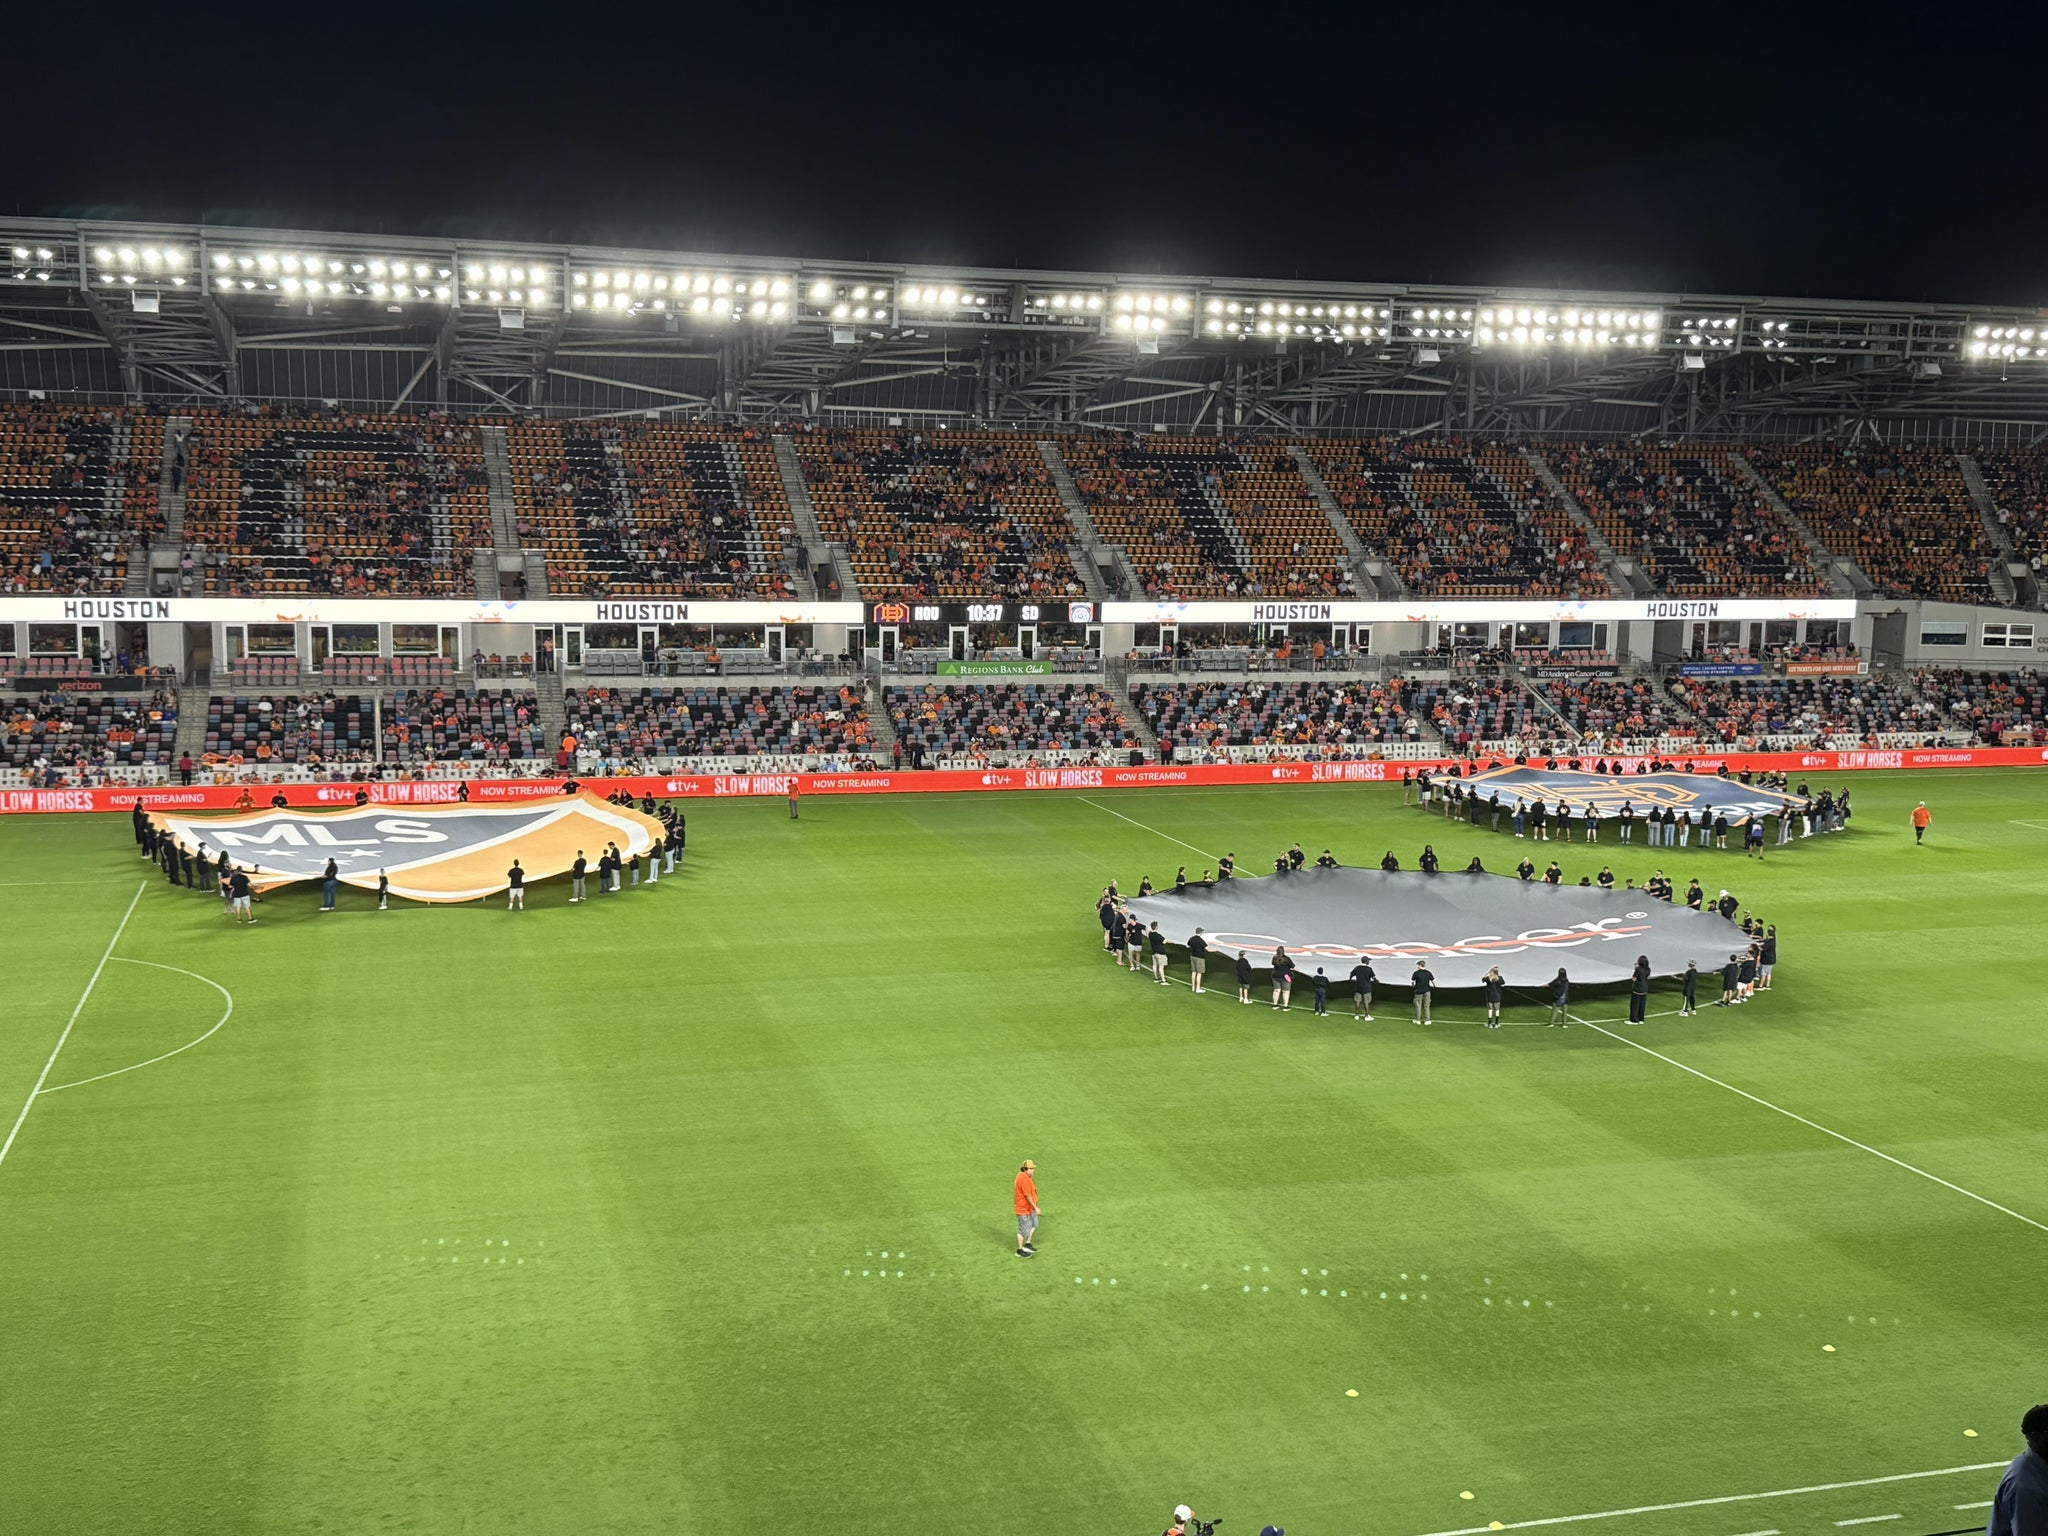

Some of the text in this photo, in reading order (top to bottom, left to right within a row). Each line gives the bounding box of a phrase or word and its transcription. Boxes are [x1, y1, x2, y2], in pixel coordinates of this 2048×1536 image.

[65, 601, 169, 618] HOUSTON
[597, 604, 689, 621] HOUSTON
[914, 606, 940, 621] HOU
[966, 605, 1003, 622] 10:37
[1021, 605, 1039, 621] SD
[1254, 604, 1331, 620] HOUSTON
[1647, 602, 1718, 617] HOUSTON
[960, 665, 1045, 674] REGIONS BANK Club
[58, 680, 102, 691] verizon
[1808, 751, 1972, 768] tv+ SLOW HORSES NOW STREAMING
[992, 770, 1187, 787] tv+ SLOW HORSES NOW STREAMING
[1281, 767, 1300, 778] tv+
[1312, 764, 1343, 780] SLOW
[1345, 763, 1385, 780] HORSES
[329, 787, 353, 799] tv+
[370, 784, 409, 803] SLOW
[480, 787, 505, 796] NOW
[678, 781, 700, 792] tv+
[714, 778, 750, 795] SLOW
[813, 780, 836, 789] NOW
[838, 778, 890, 788] STREAMING
[37, 791, 93, 811] HORSES
[110, 793, 205, 804] NOW STREAMING
[210, 819, 449, 847] MLS
